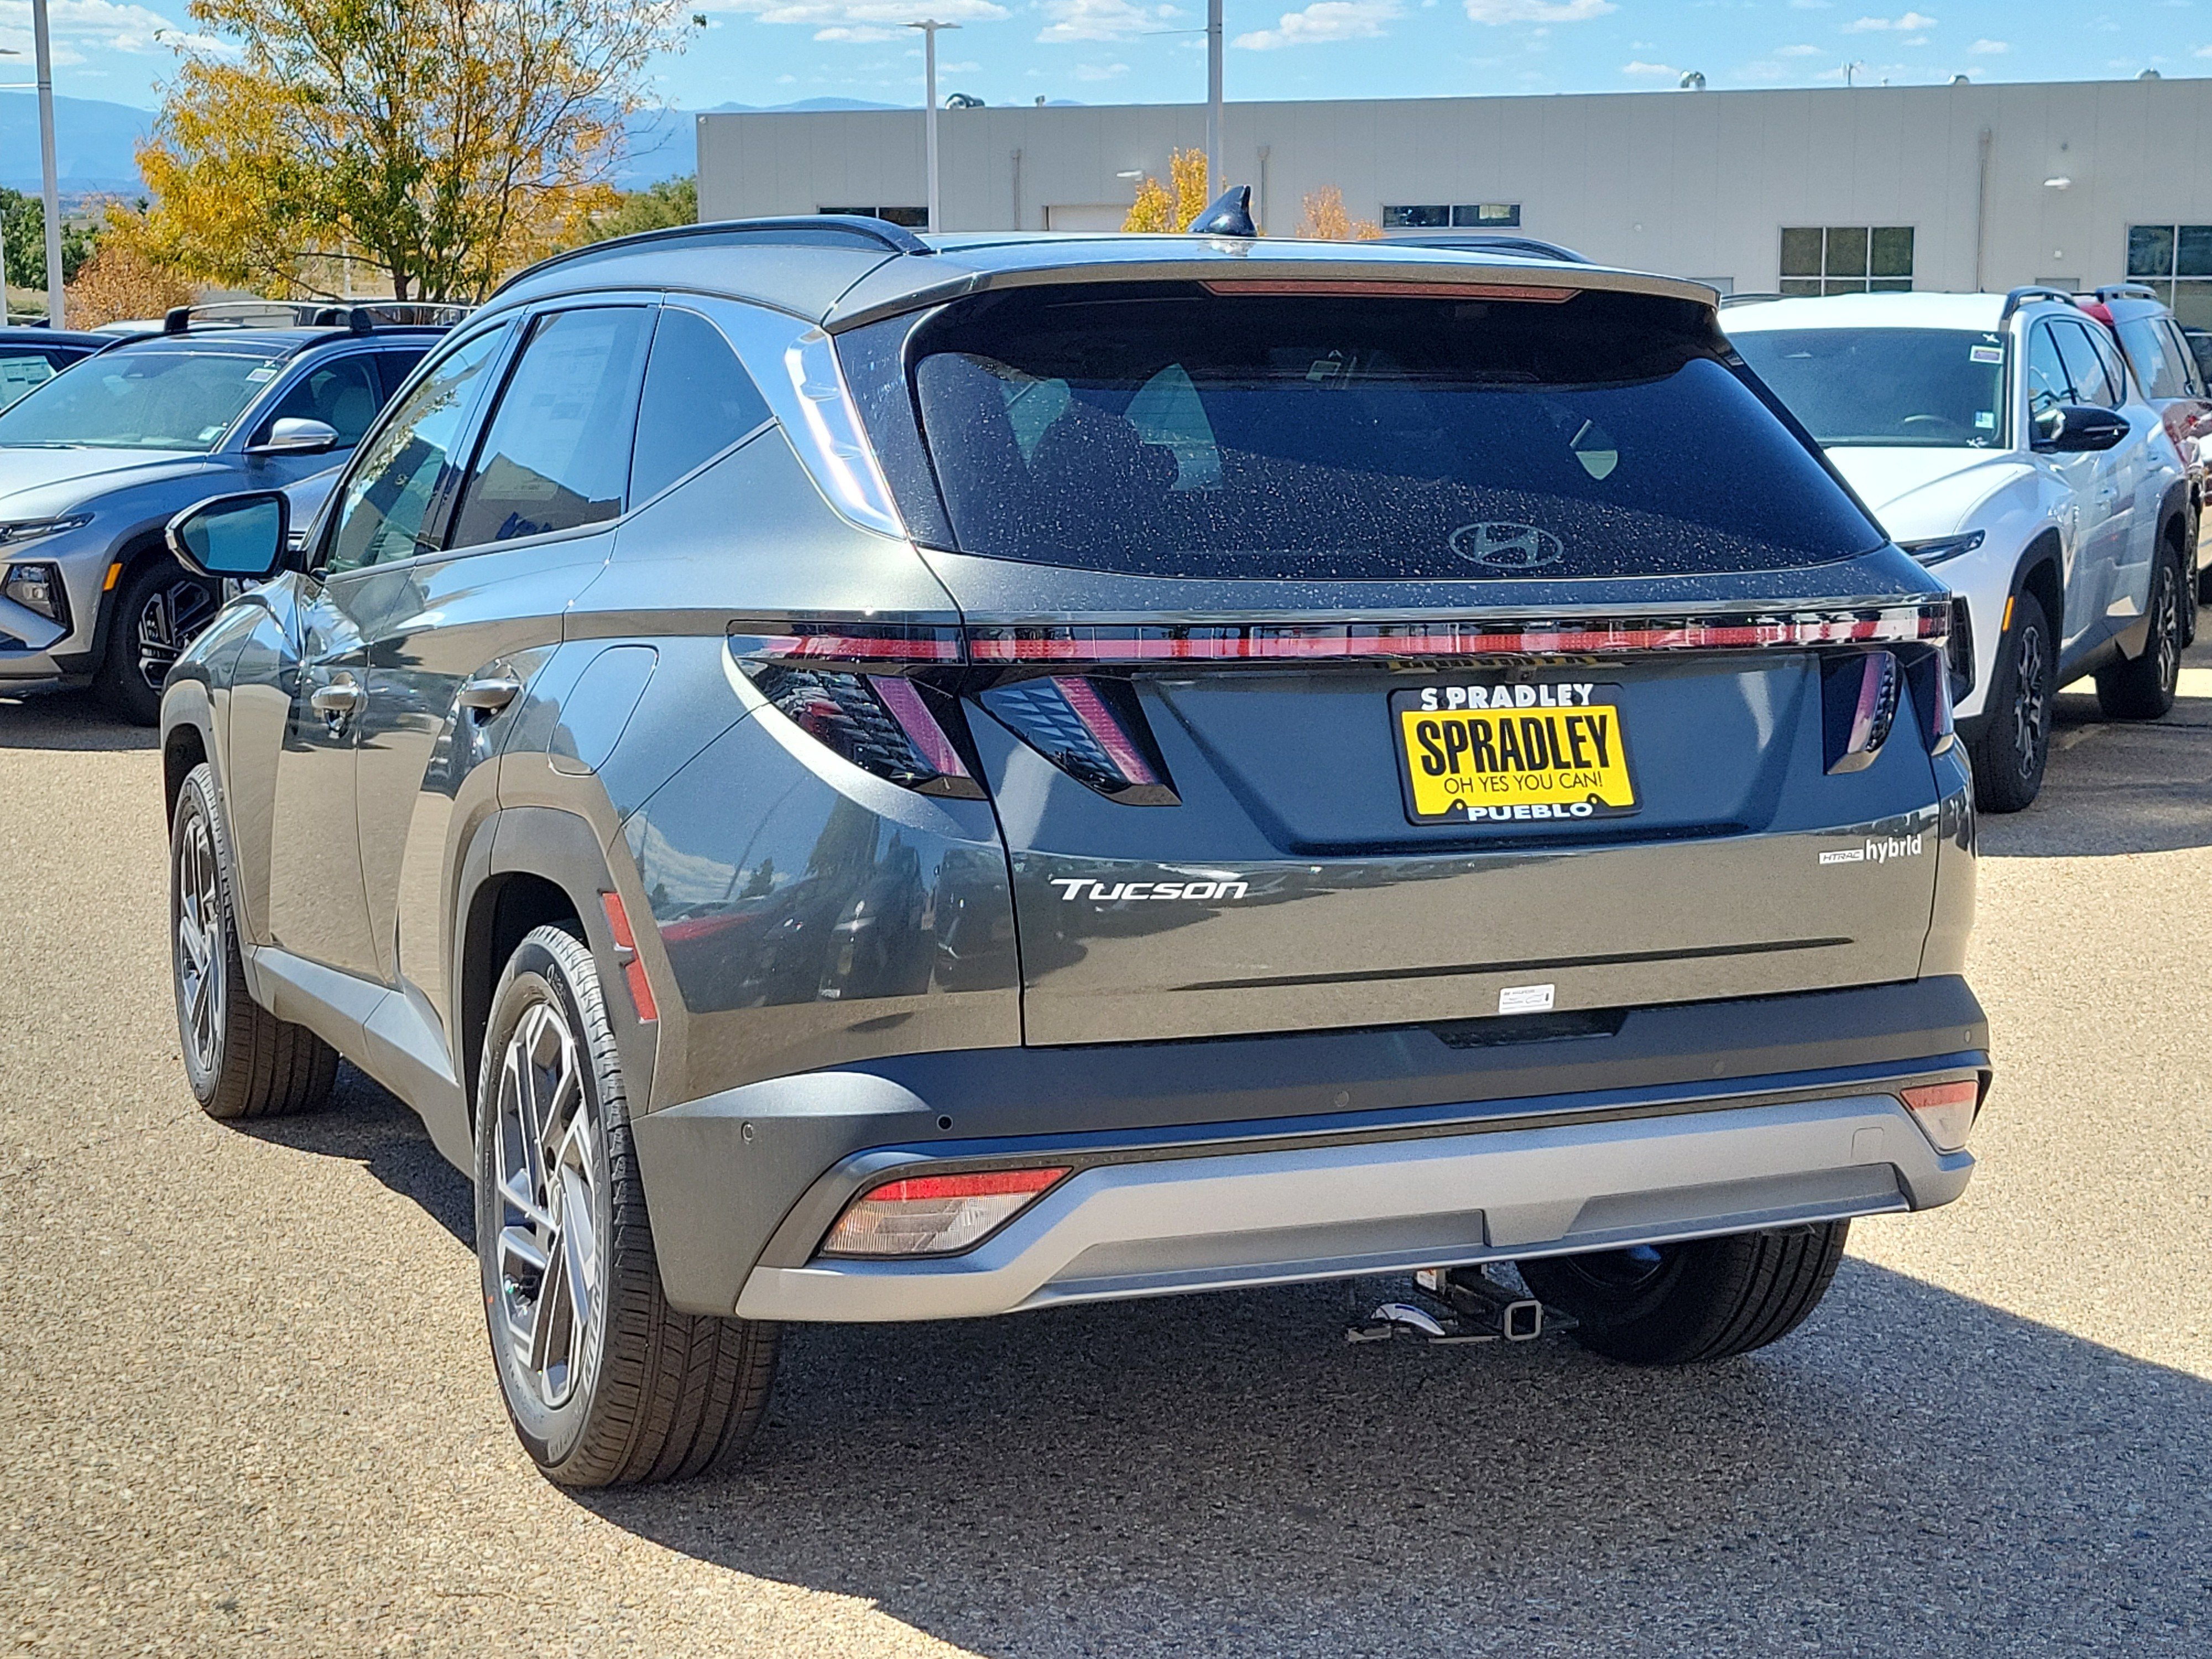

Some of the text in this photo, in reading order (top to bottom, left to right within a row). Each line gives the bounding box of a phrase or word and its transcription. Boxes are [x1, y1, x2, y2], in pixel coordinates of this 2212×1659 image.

[1416, 714, 1610, 776] SPRADLEY
[1444, 771, 1603, 794] OH YES YOU CAN!
[1467, 802, 1594, 821] PUEBLO
[1823, 833, 1922, 864] HTRAC hybrid
